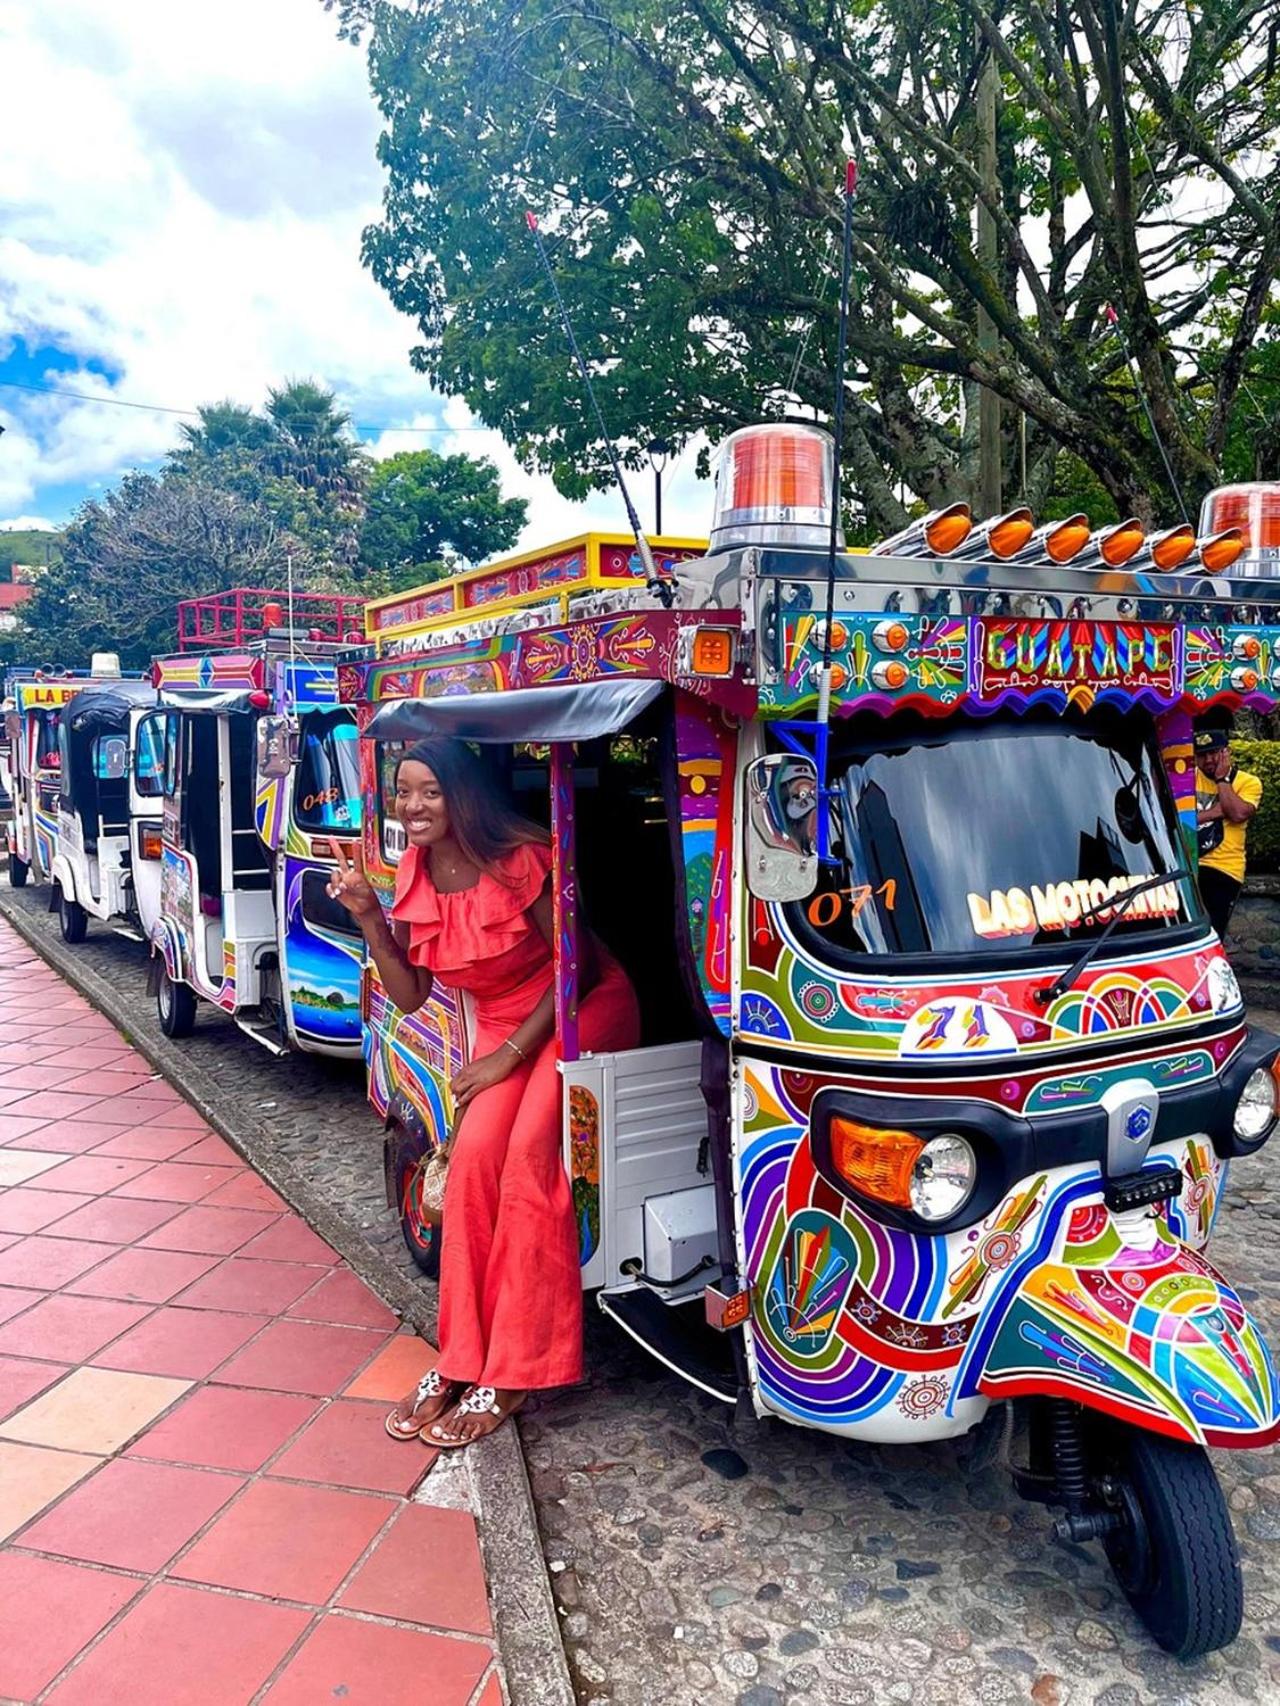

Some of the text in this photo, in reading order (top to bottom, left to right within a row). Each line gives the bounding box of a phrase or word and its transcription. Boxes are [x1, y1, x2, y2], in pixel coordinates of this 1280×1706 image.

[34, 689, 56, 703] LA
[808, 878, 896, 926] 071
[967, 887, 1037, 939] LAS
[916, 1005, 990, 1049] 71
